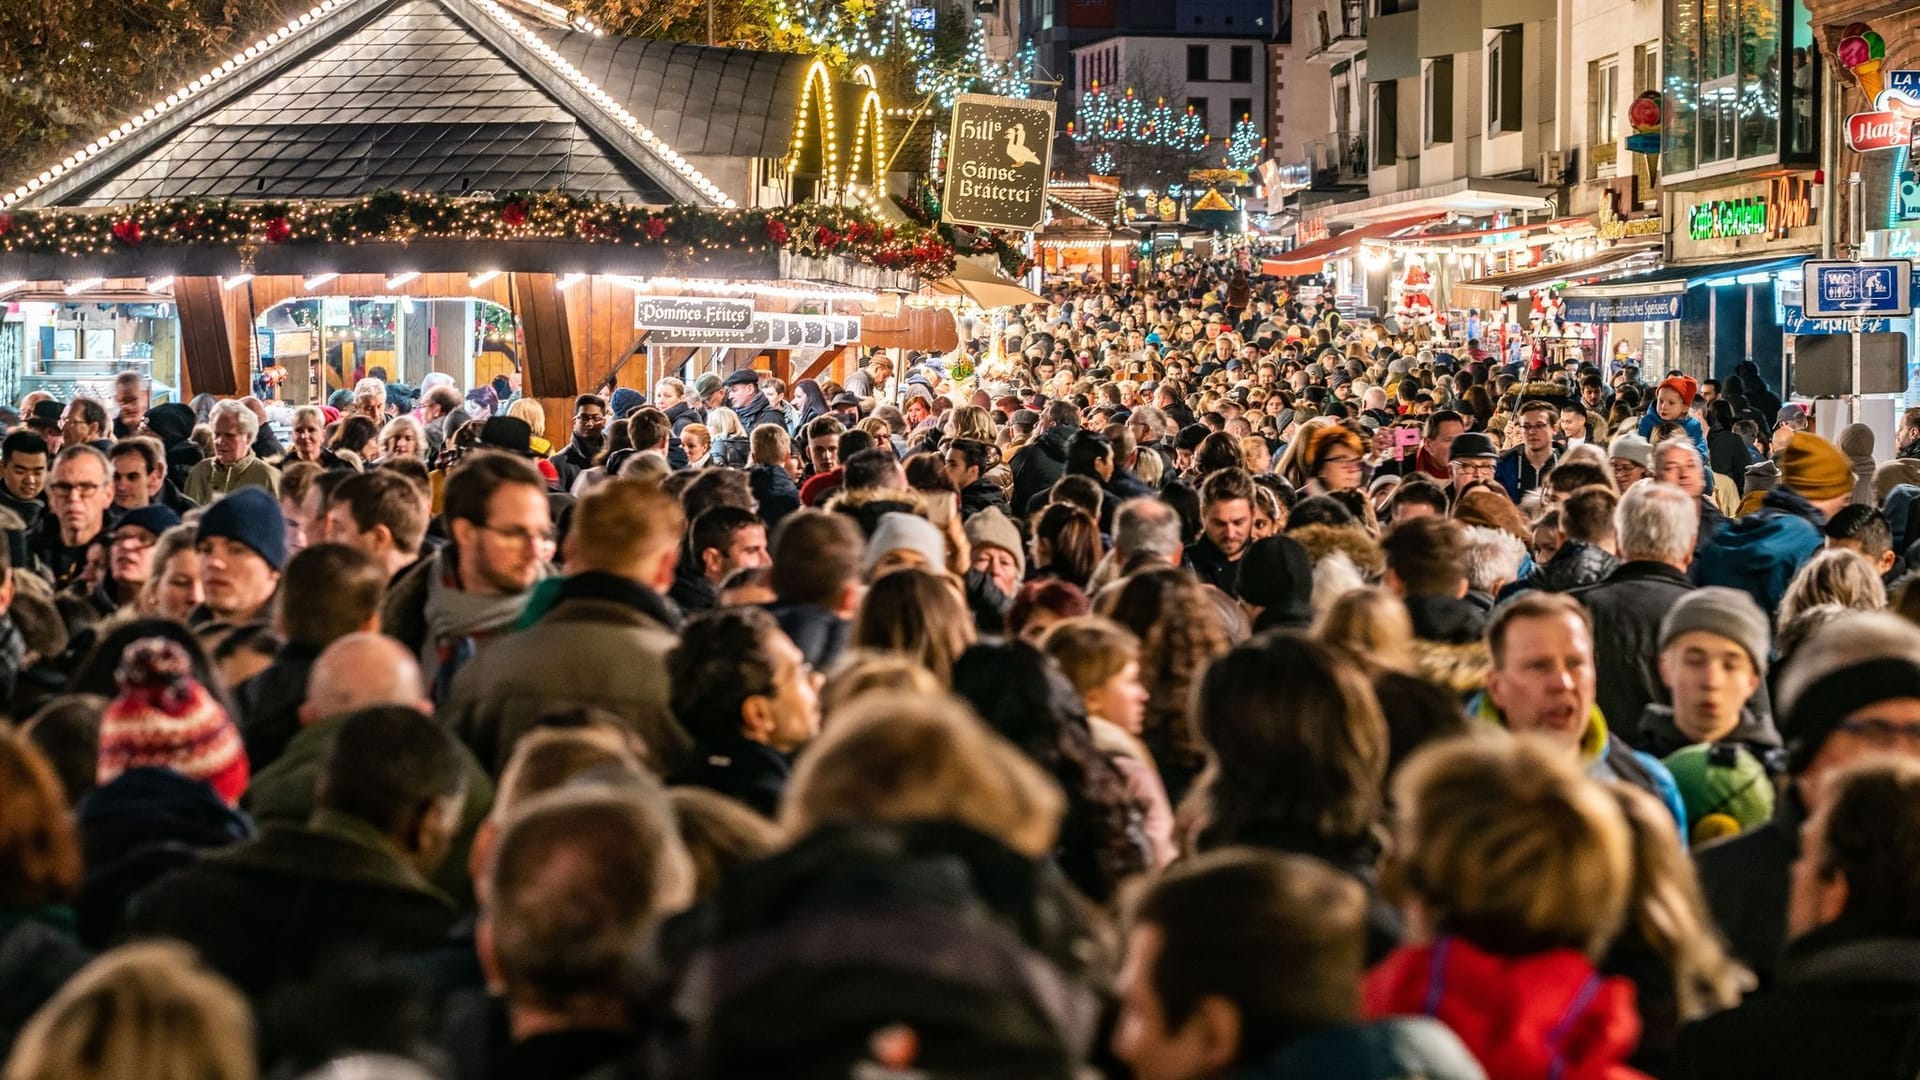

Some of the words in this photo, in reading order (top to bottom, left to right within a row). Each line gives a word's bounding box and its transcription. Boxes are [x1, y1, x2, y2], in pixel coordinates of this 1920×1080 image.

[1894, 74, 1912, 85] LA
[1828, 273, 1851, 285] WC
[643, 303, 701, 322] Pommes
[706, 306, 745, 323] Frites
